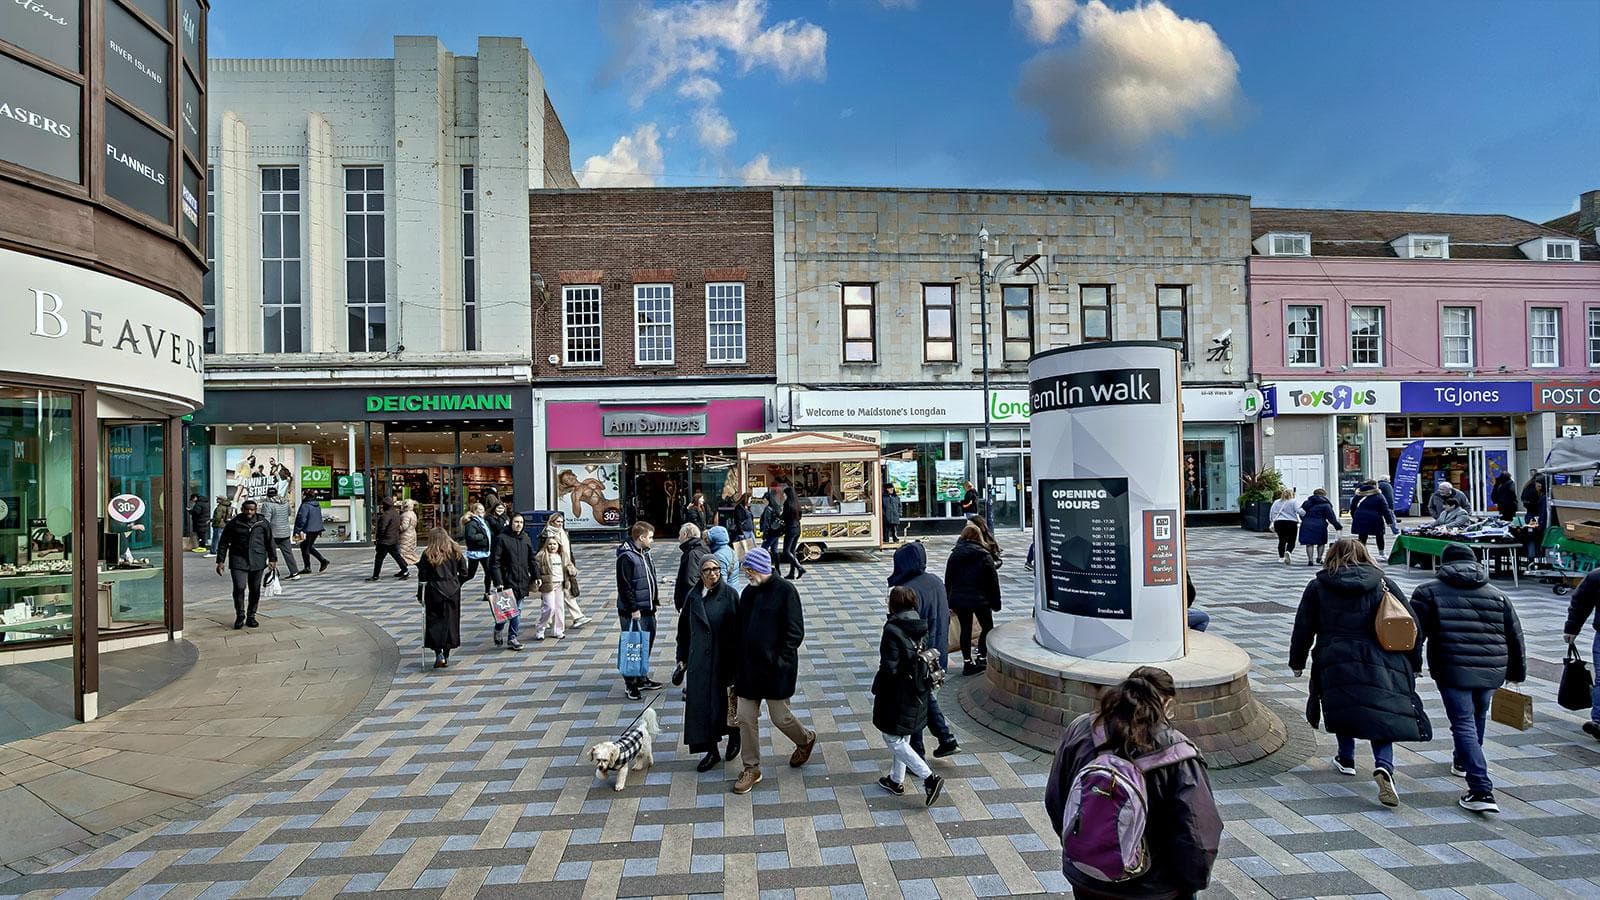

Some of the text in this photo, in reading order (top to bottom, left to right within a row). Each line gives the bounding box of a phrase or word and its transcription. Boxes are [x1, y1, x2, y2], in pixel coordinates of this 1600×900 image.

[110, 40, 162, 83] RIVER ISLAND
[106, 143, 165, 185] FLANNELS
[1090, 374, 1152, 402] walk
[1541, 388, 1584, 405] POST
[366, 394, 512, 412] DEICHMANN
[805, 407, 947, 418] Welcome to Maidstone's Longdan
[610, 418, 700, 433] Ann Summers
[1052, 489, 1107, 499] OPENING
[1057, 500, 1100, 510] HOURS
